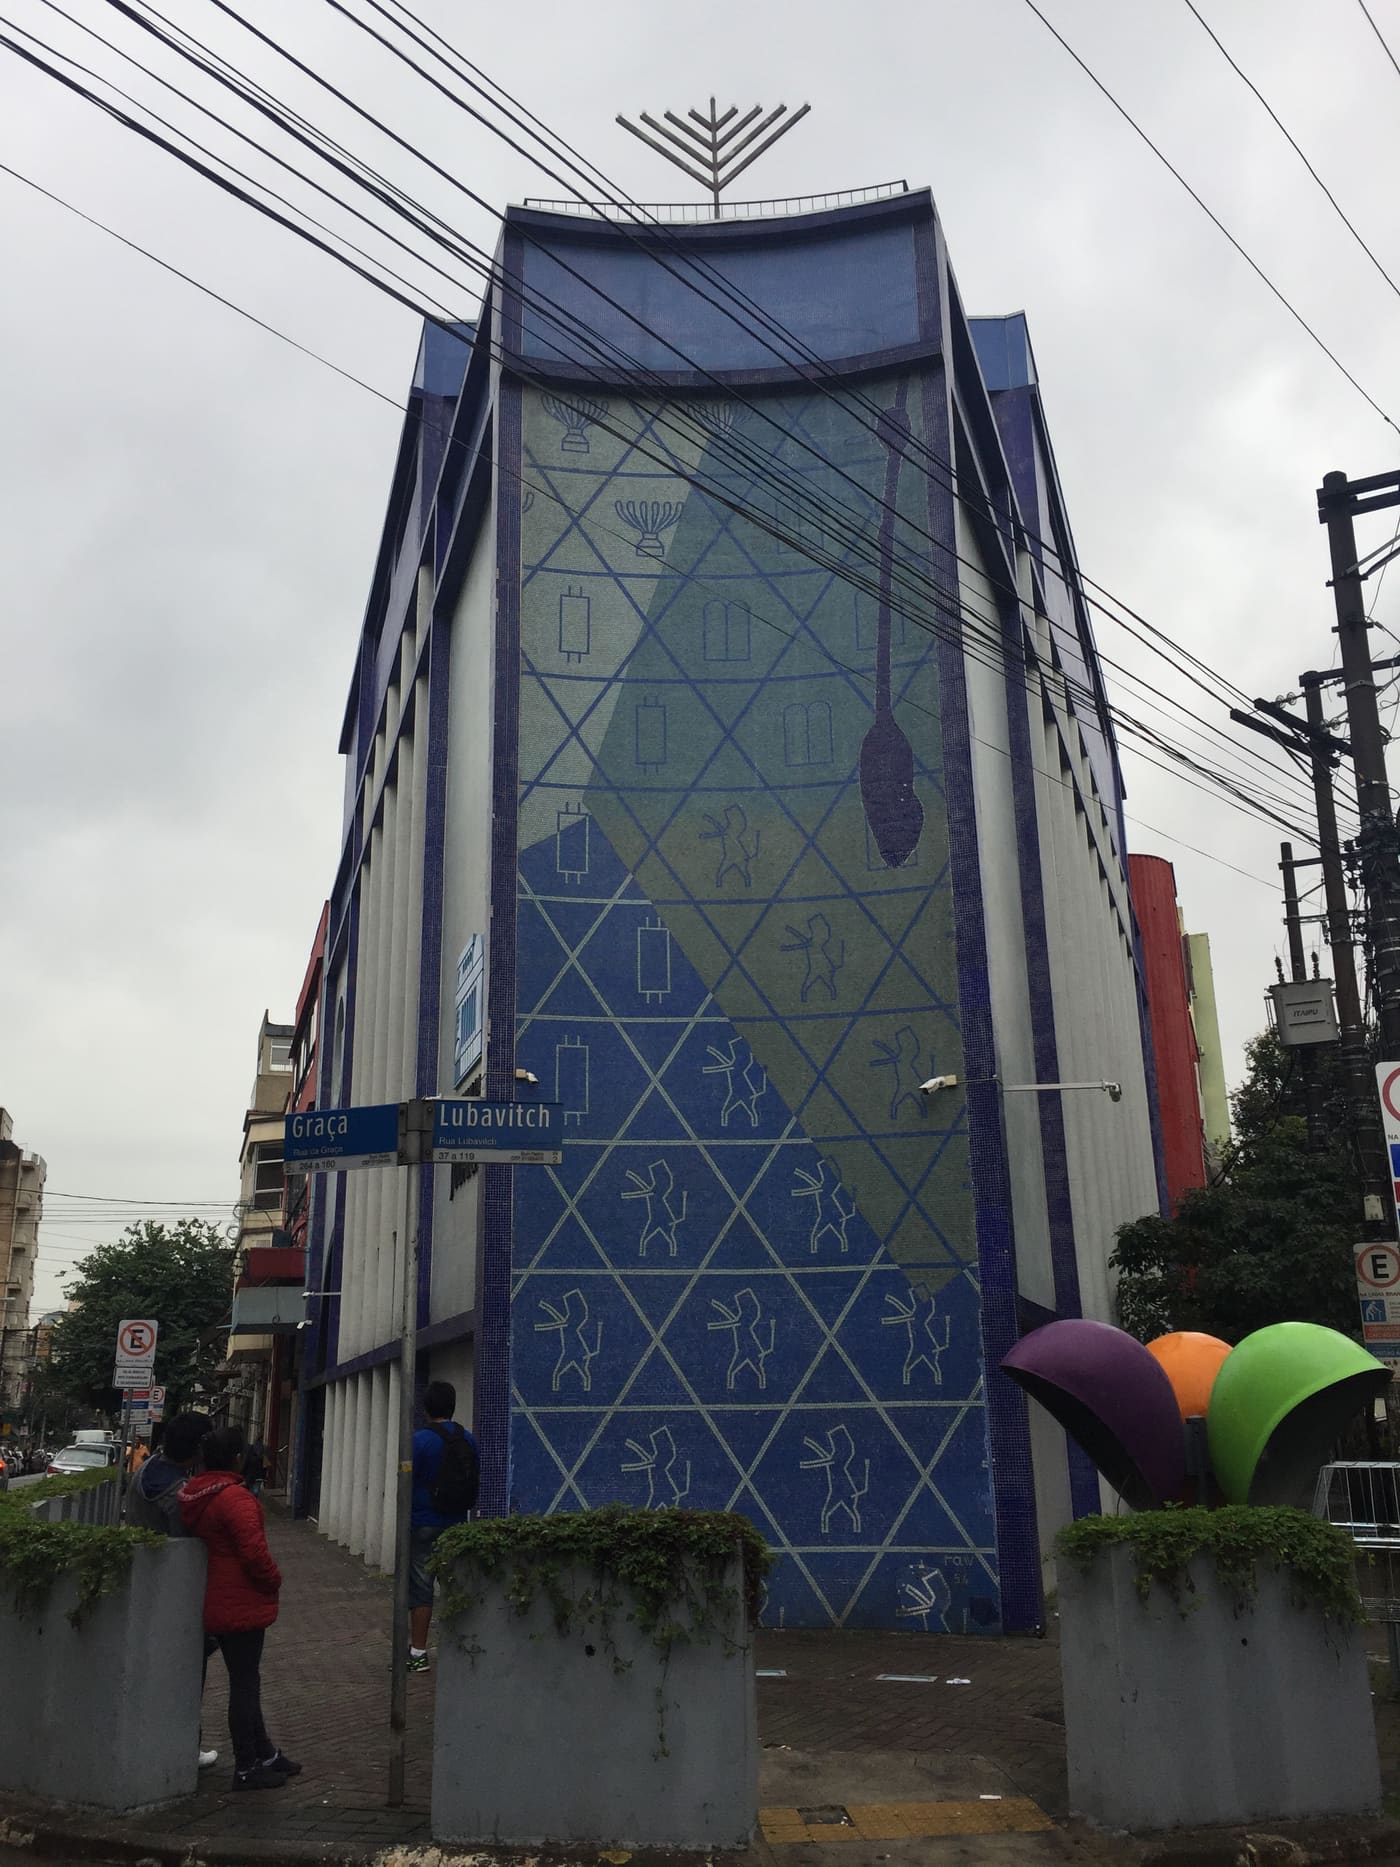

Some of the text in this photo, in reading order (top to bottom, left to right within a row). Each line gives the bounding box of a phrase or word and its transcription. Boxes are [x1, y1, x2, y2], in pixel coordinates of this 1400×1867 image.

[440, 1103, 550, 1128] Lubavitch
[292, 1115, 348, 1142] Graça
[439, 1137, 497, 1145] Rua Lubavitch
[438, 1152, 449, 1160] 37
[460, 1152, 475, 1160] 119
[1371, 1254, 1389, 1278] E
[130, 1329, 144, 1349] E
